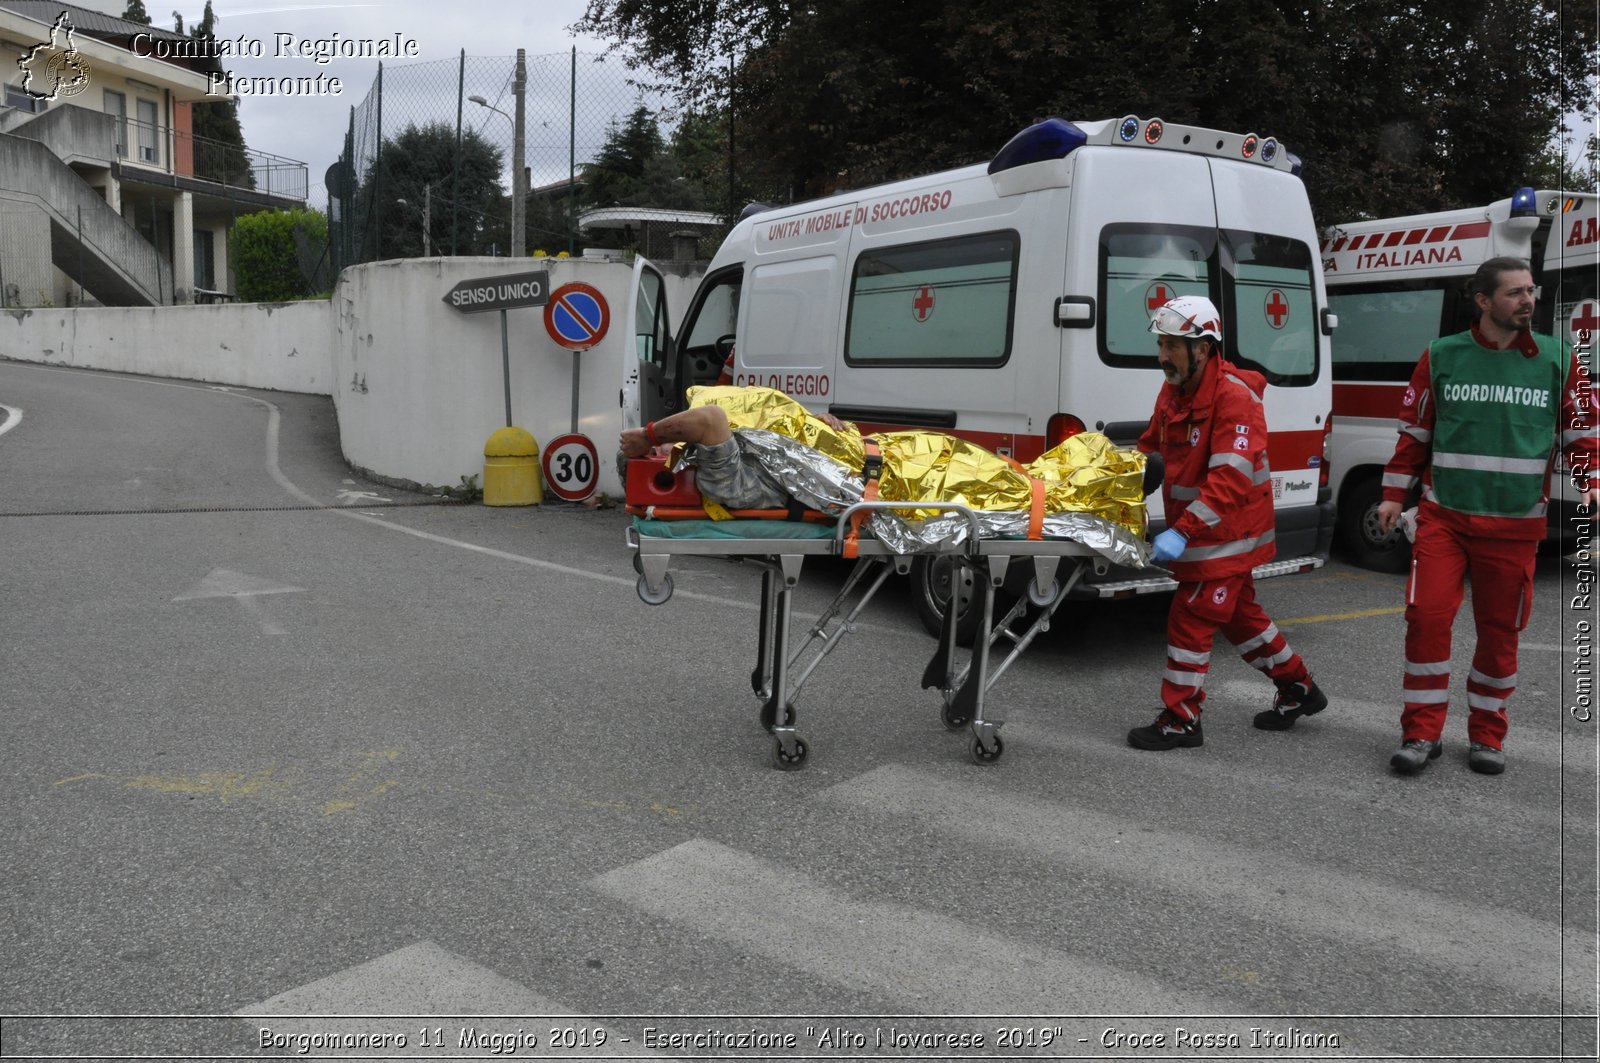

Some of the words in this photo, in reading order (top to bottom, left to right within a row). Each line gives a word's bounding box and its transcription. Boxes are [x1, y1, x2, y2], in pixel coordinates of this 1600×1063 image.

[805, 209, 851, 234] MOBILE
[854, 208, 868, 226] DI
[872, 190, 952, 222] SOCCORSO
[1357, 246, 1462, 270] ITALIANA
[452, 286, 496, 306] SENSO
[498, 281, 541, 301] UNICO
[769, 374, 830, 396] OLEGGIO
[1443, 384, 1549, 408] COORDINATORE
[555, 453, 592, 483] 30
